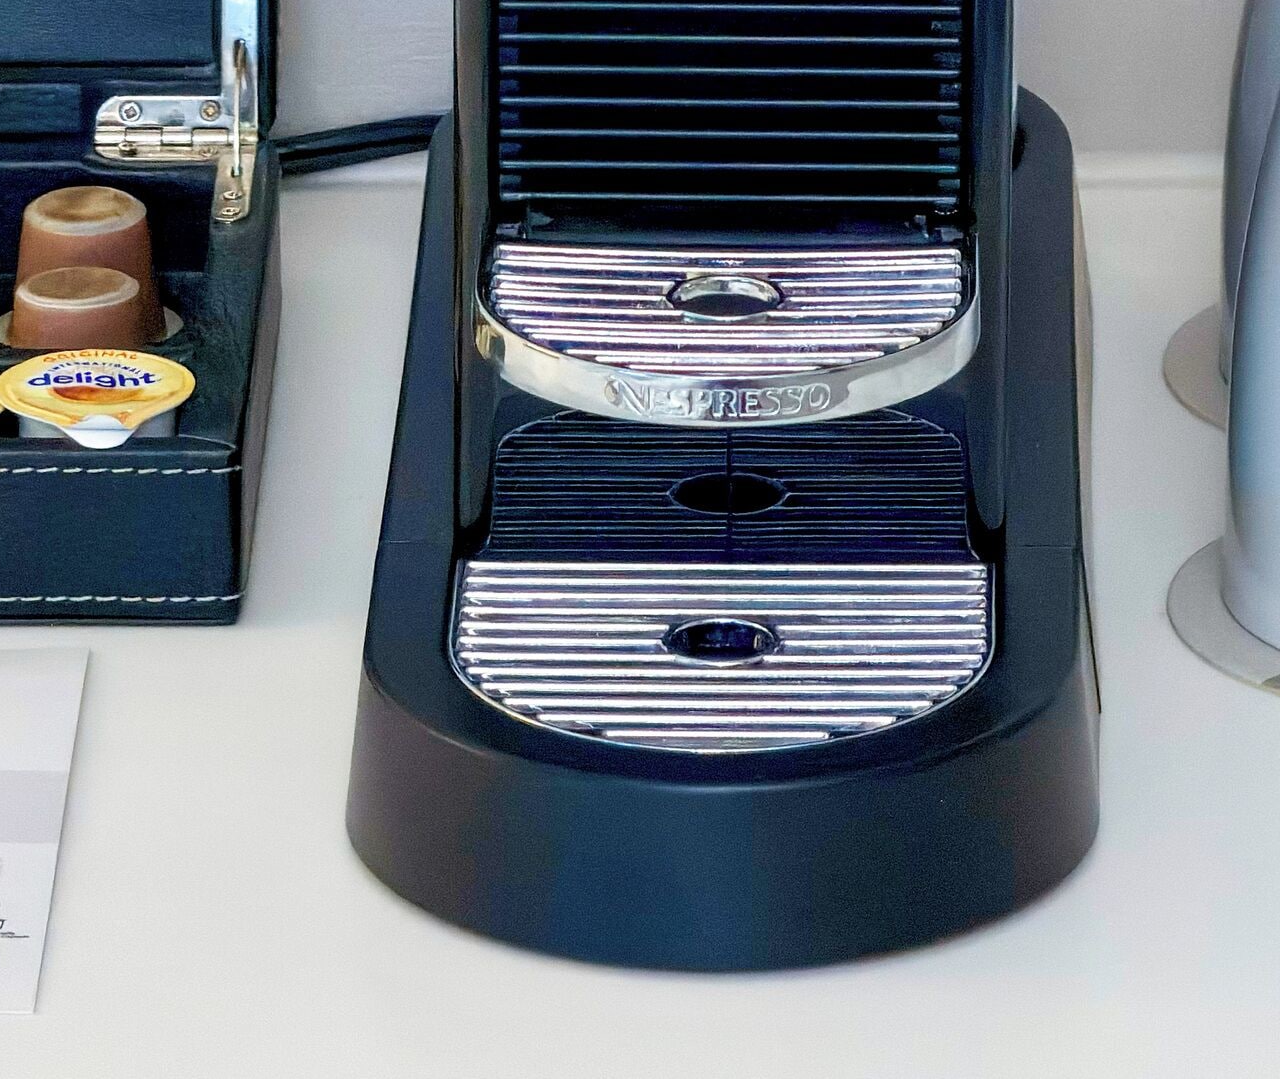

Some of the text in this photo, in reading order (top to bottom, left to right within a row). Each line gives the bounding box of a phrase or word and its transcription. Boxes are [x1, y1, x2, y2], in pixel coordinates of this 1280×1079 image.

[43, 350, 137, 362] ORIGINAL
[27, 371, 157, 388] delight
[605, 375, 831, 417] NESPRESSO
